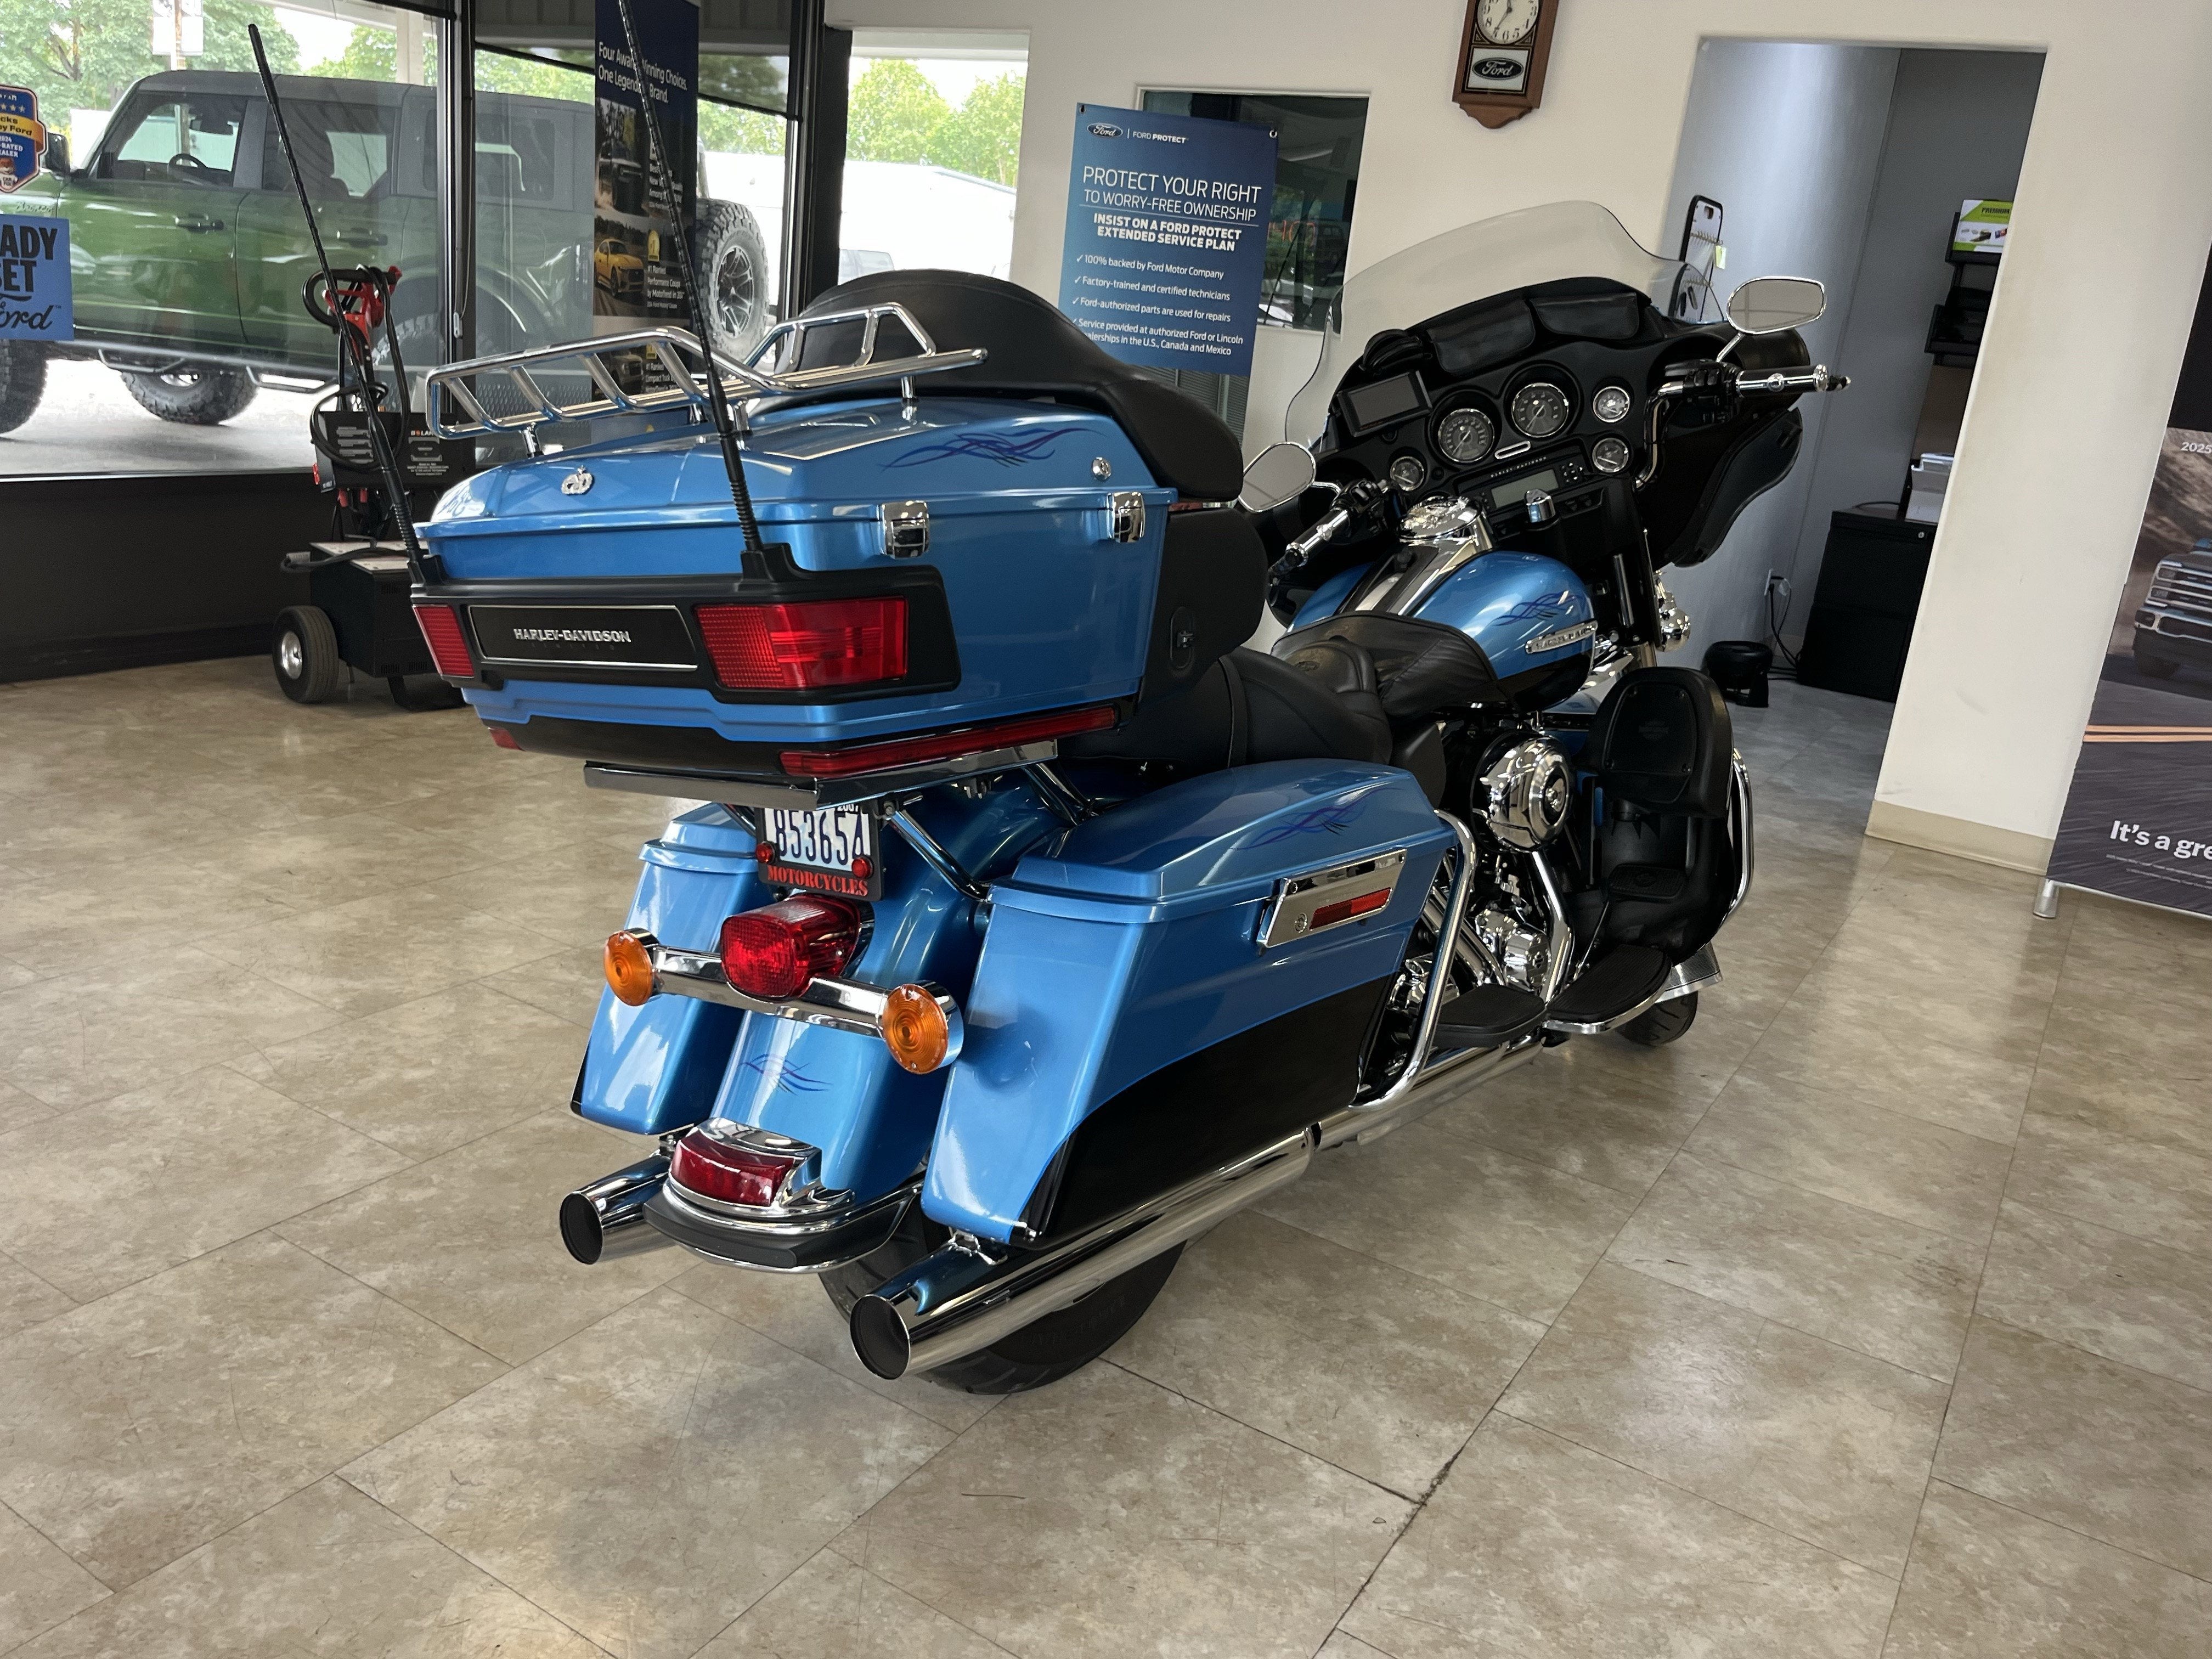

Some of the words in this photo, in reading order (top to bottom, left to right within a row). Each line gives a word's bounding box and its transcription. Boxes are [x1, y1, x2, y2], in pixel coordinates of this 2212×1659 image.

[599, 41, 615, 61] Four
[599, 64, 614, 84] One
[1482, 60, 1514, 76] Ford
[10, 125, 32, 136] Ford
[1093, 125, 1116, 137] Ford
[1133, 131, 1152, 139] FORD
[1153, 133, 1186, 144] PROTECT
[1083, 166, 1159, 191] PROTECT
[1163, 176, 1209, 198] YOUR
[1211, 182, 1262, 204] RIGHT
[1084, 189, 1100, 204] TO
[1103, 192, 1182, 213] WORRY-FREE
[1184, 202, 1256, 222] OWNERSHIP
[1094, 213, 1131, 228] INSIST
[1132, 218, 1148, 229] ON
[1150, 221, 1158, 231] A
[1160, 221, 1190, 235] FORD
[1192, 225, 1242, 240] PROTECT
[1097, 226, 1155, 242] EXTENDED
[1157, 233, 1204, 248] SERVICE
[1205, 239, 1235, 252] PLAN
[1085, 255, 1107, 266] 100%
[1108, 258, 1135, 269] backed
[1137, 261, 1146, 272] by
[1147, 262, 1164, 273] Ford
[1165, 264, 1187, 275] Motor
[1189, 267, 1224, 280] Company
[1082, 276, 1139, 291] Factory-trained
[1141, 283, 1155, 292] and
[1157, 284, 1187, 297] certified
[1188, 288, 1230, 301] technicians
[1080, 297, 1140, 312] Ford-authorized
[1141, 303, 1160, 314] parts
[1161, 307, 1173, 315] are
[1175, 307, 1193, 318] used
[1194, 309, 1205, 319] for
[1206, 312, 1231, 323] repairs
[1079, 318, 1104, 329] Service
[1105, 323, 1138, 334] provided
[1139, 326, 1148, 335] at
[1149, 327, 1188, 338] authorized
[1189, 330, 1206, 341] Ford
[1216, 334, 1243, 345] Lincoln
[1121, 336, 1128, 344] in
[1129, 337, 1142, 346] the
[1143, 339, 1159, 349] U.S.,
[1160, 340, 1188, 351] Canada
[1190, 343, 1204, 353] and
[1206, 345, 1231, 355] Mexico
[2181, 442, 2212, 454] 2025
[513, 629, 631, 642] HARLEY-DAVIDSON
[2154, 835, 2171, 850] a
[768, 865, 868, 897] MOTORCYCLES
